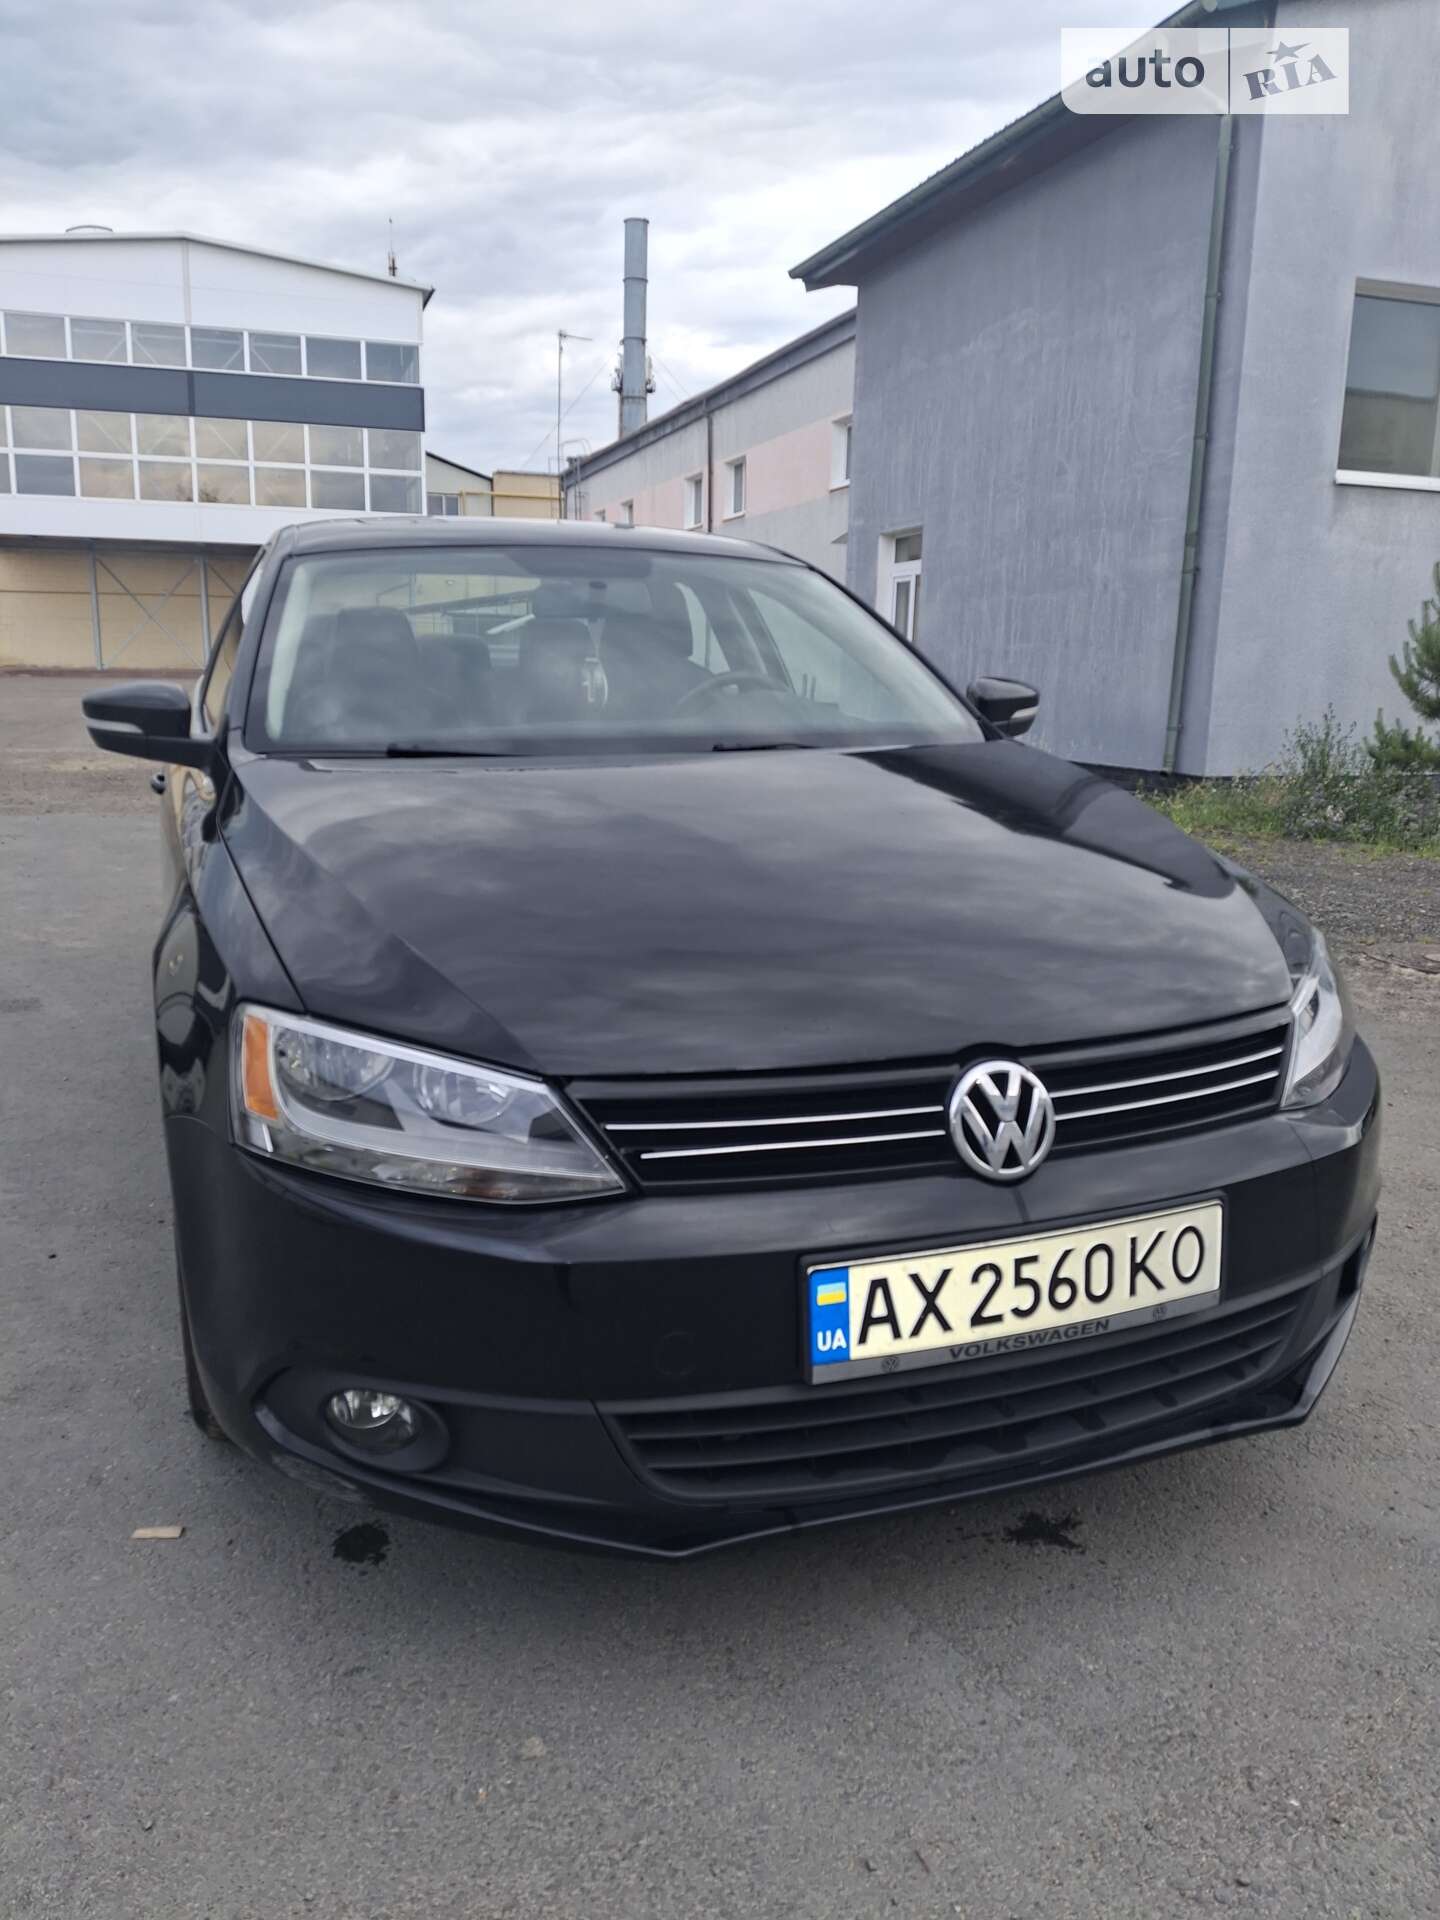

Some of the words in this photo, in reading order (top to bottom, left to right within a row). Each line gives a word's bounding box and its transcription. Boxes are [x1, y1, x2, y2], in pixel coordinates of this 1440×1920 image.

[858, 1268, 953, 1345] AX
[970, 1243, 1115, 1328] 2560
[1129, 1225, 1206, 1297] KO
[817, 1328, 847, 1352] UA
[949, 1319, 1110, 1361] VOLKSWAGEN
